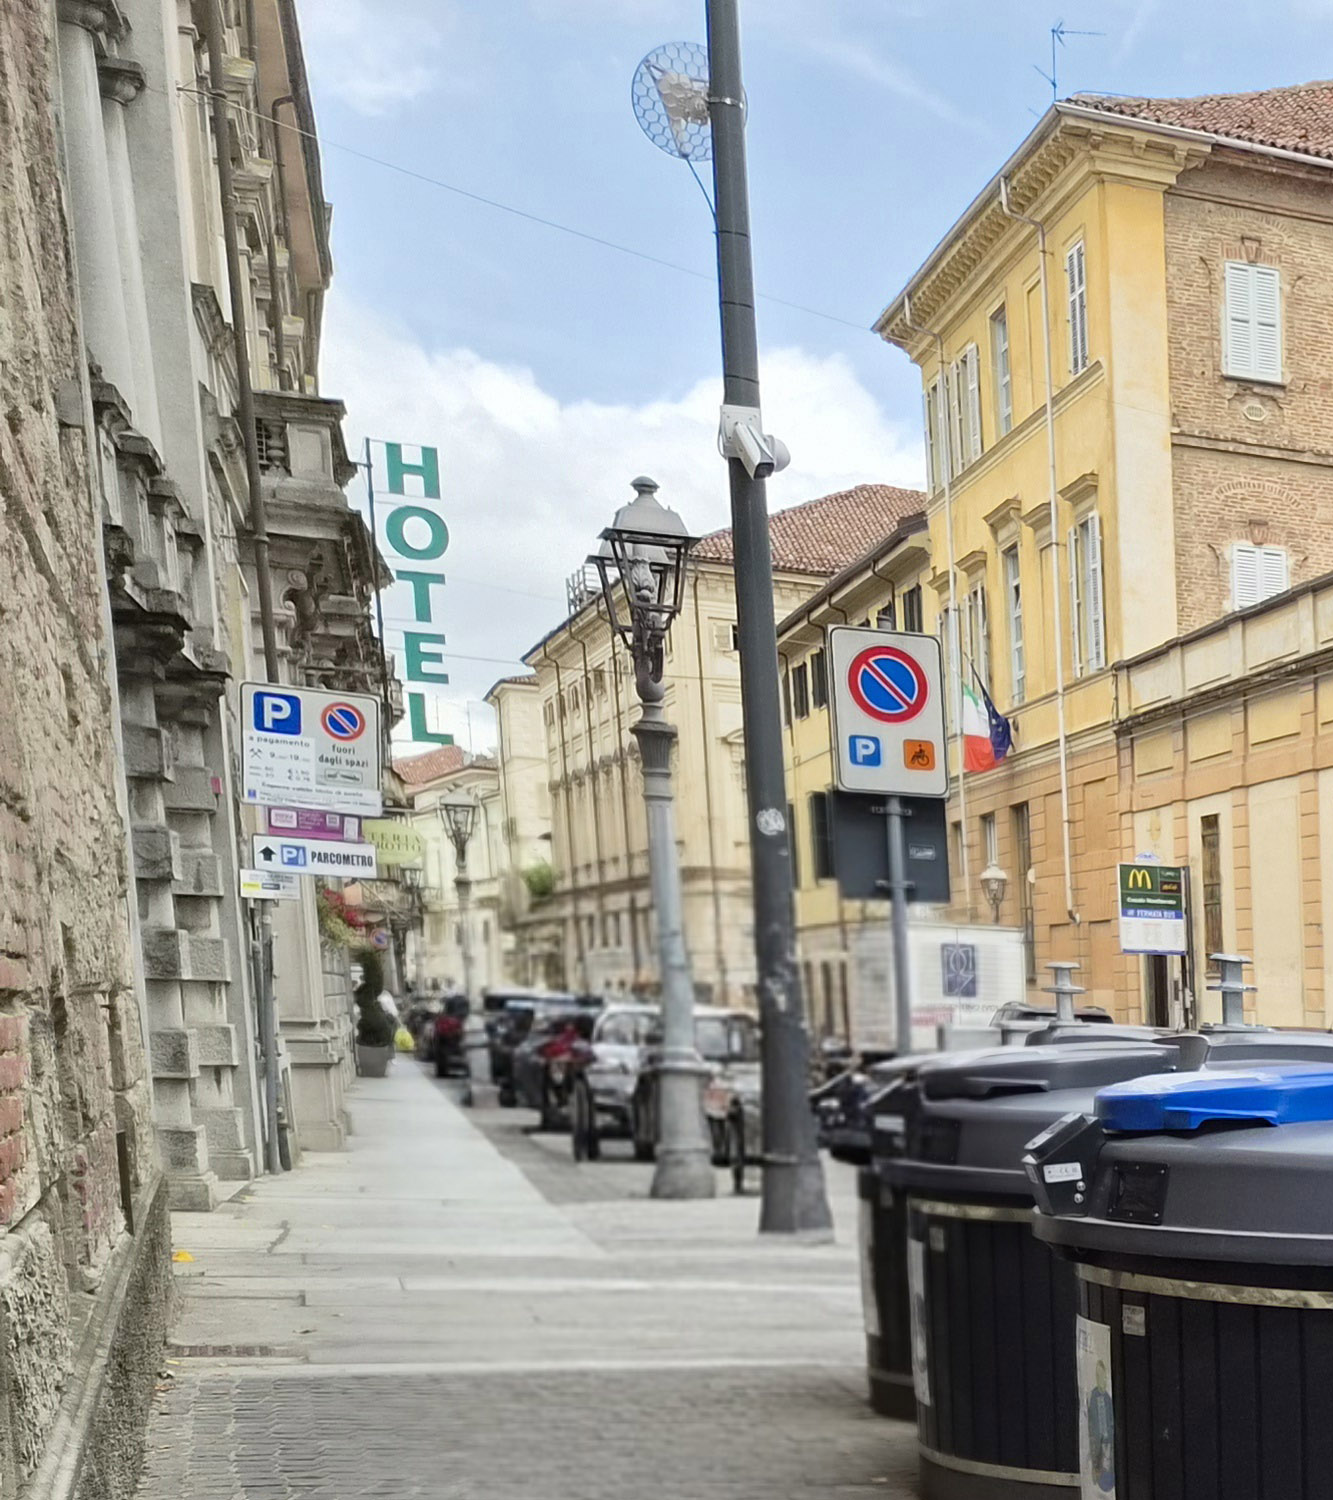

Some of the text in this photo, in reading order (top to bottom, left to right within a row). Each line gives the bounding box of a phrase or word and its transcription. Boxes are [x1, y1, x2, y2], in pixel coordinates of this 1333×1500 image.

[385, 442, 455, 747] HOTEL
[263, 696, 291, 729] P
[256, 737, 310, 748] pagamento
[331, 744, 355, 756] fuori
[855, 738, 876, 763] P
[318, 754, 370, 768] dagli spazi
[311, 851, 374, 867] PARCOMETRO
